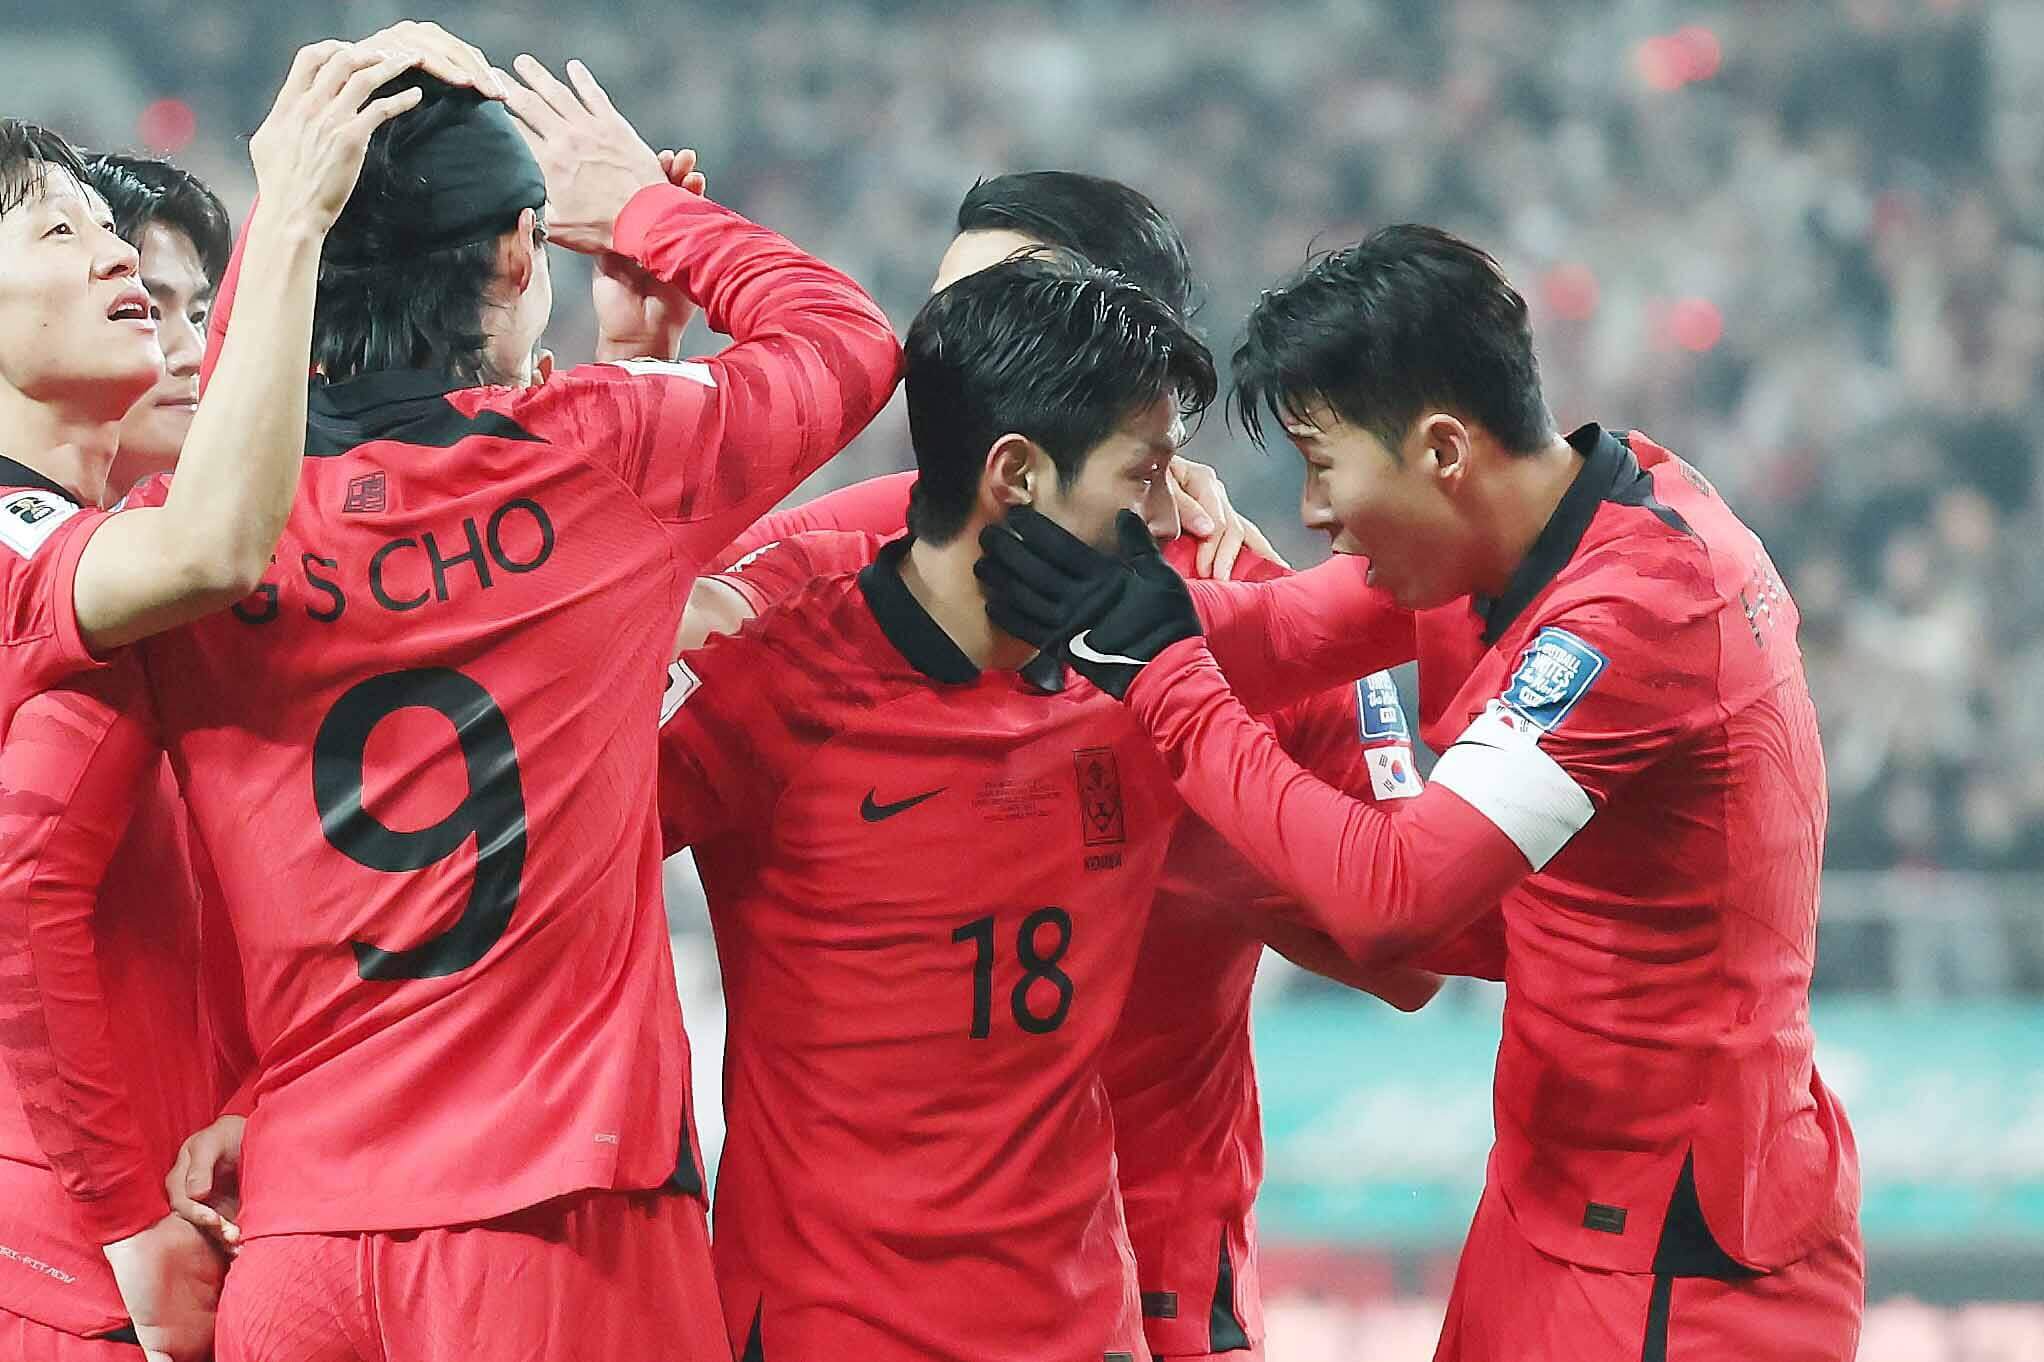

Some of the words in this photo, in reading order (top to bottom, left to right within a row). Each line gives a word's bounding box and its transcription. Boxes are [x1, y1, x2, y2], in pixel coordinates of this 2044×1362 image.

[301, 552, 346, 623] S
[369, 498, 555, 612] CHO
[312, 666, 528, 981] 9
[952, 906, 1074, 1039] 18
